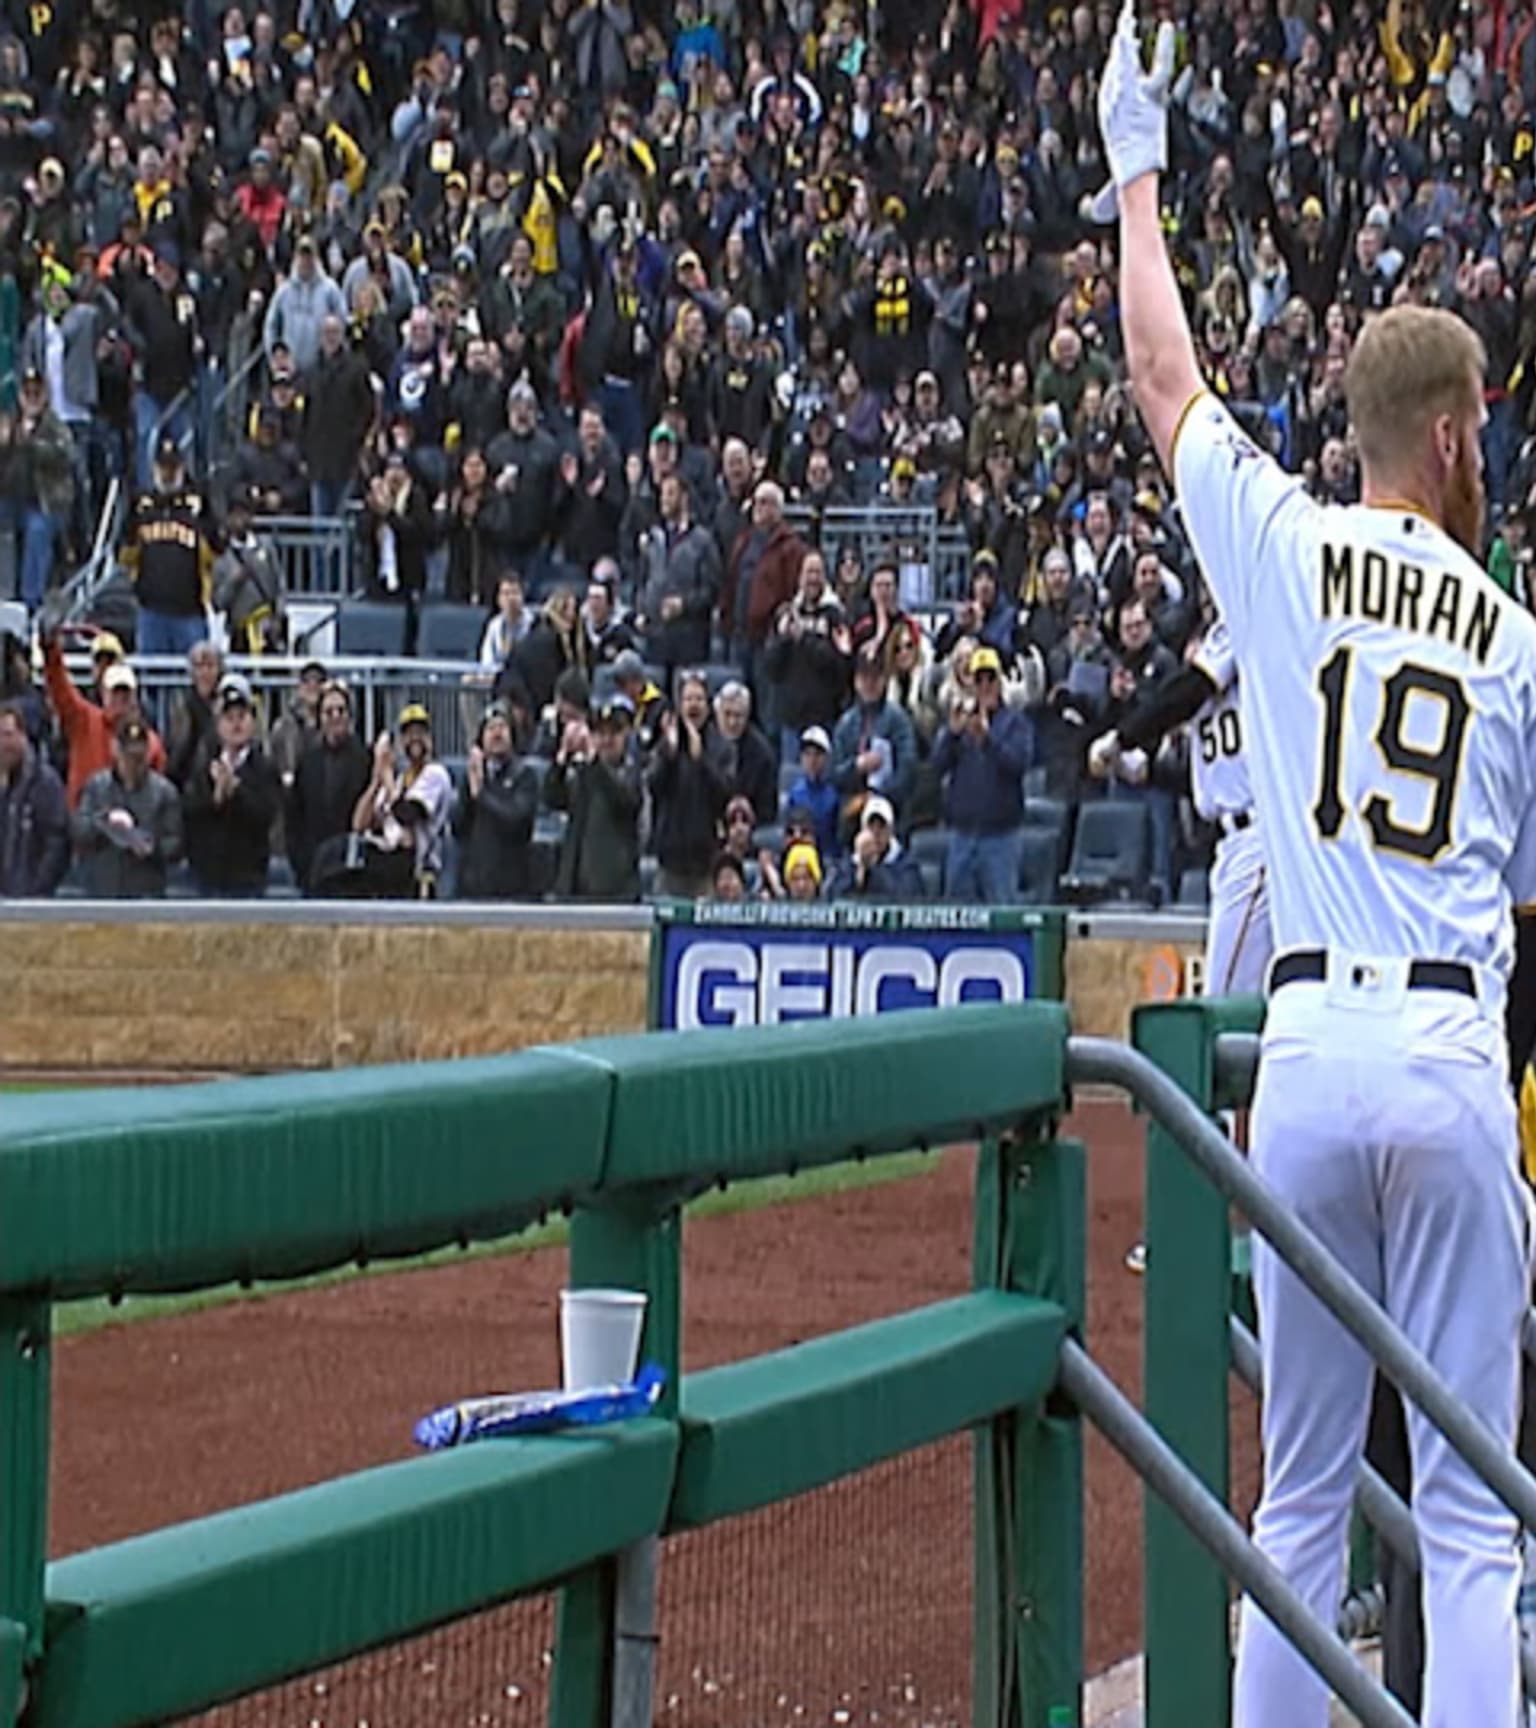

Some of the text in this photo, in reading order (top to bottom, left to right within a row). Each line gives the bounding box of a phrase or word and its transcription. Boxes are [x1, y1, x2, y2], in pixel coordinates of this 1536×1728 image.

[1319, 542, 1502, 667] MORAN
[1199, 708, 1241, 764] 50
[1312, 646, 1474, 864] 19
